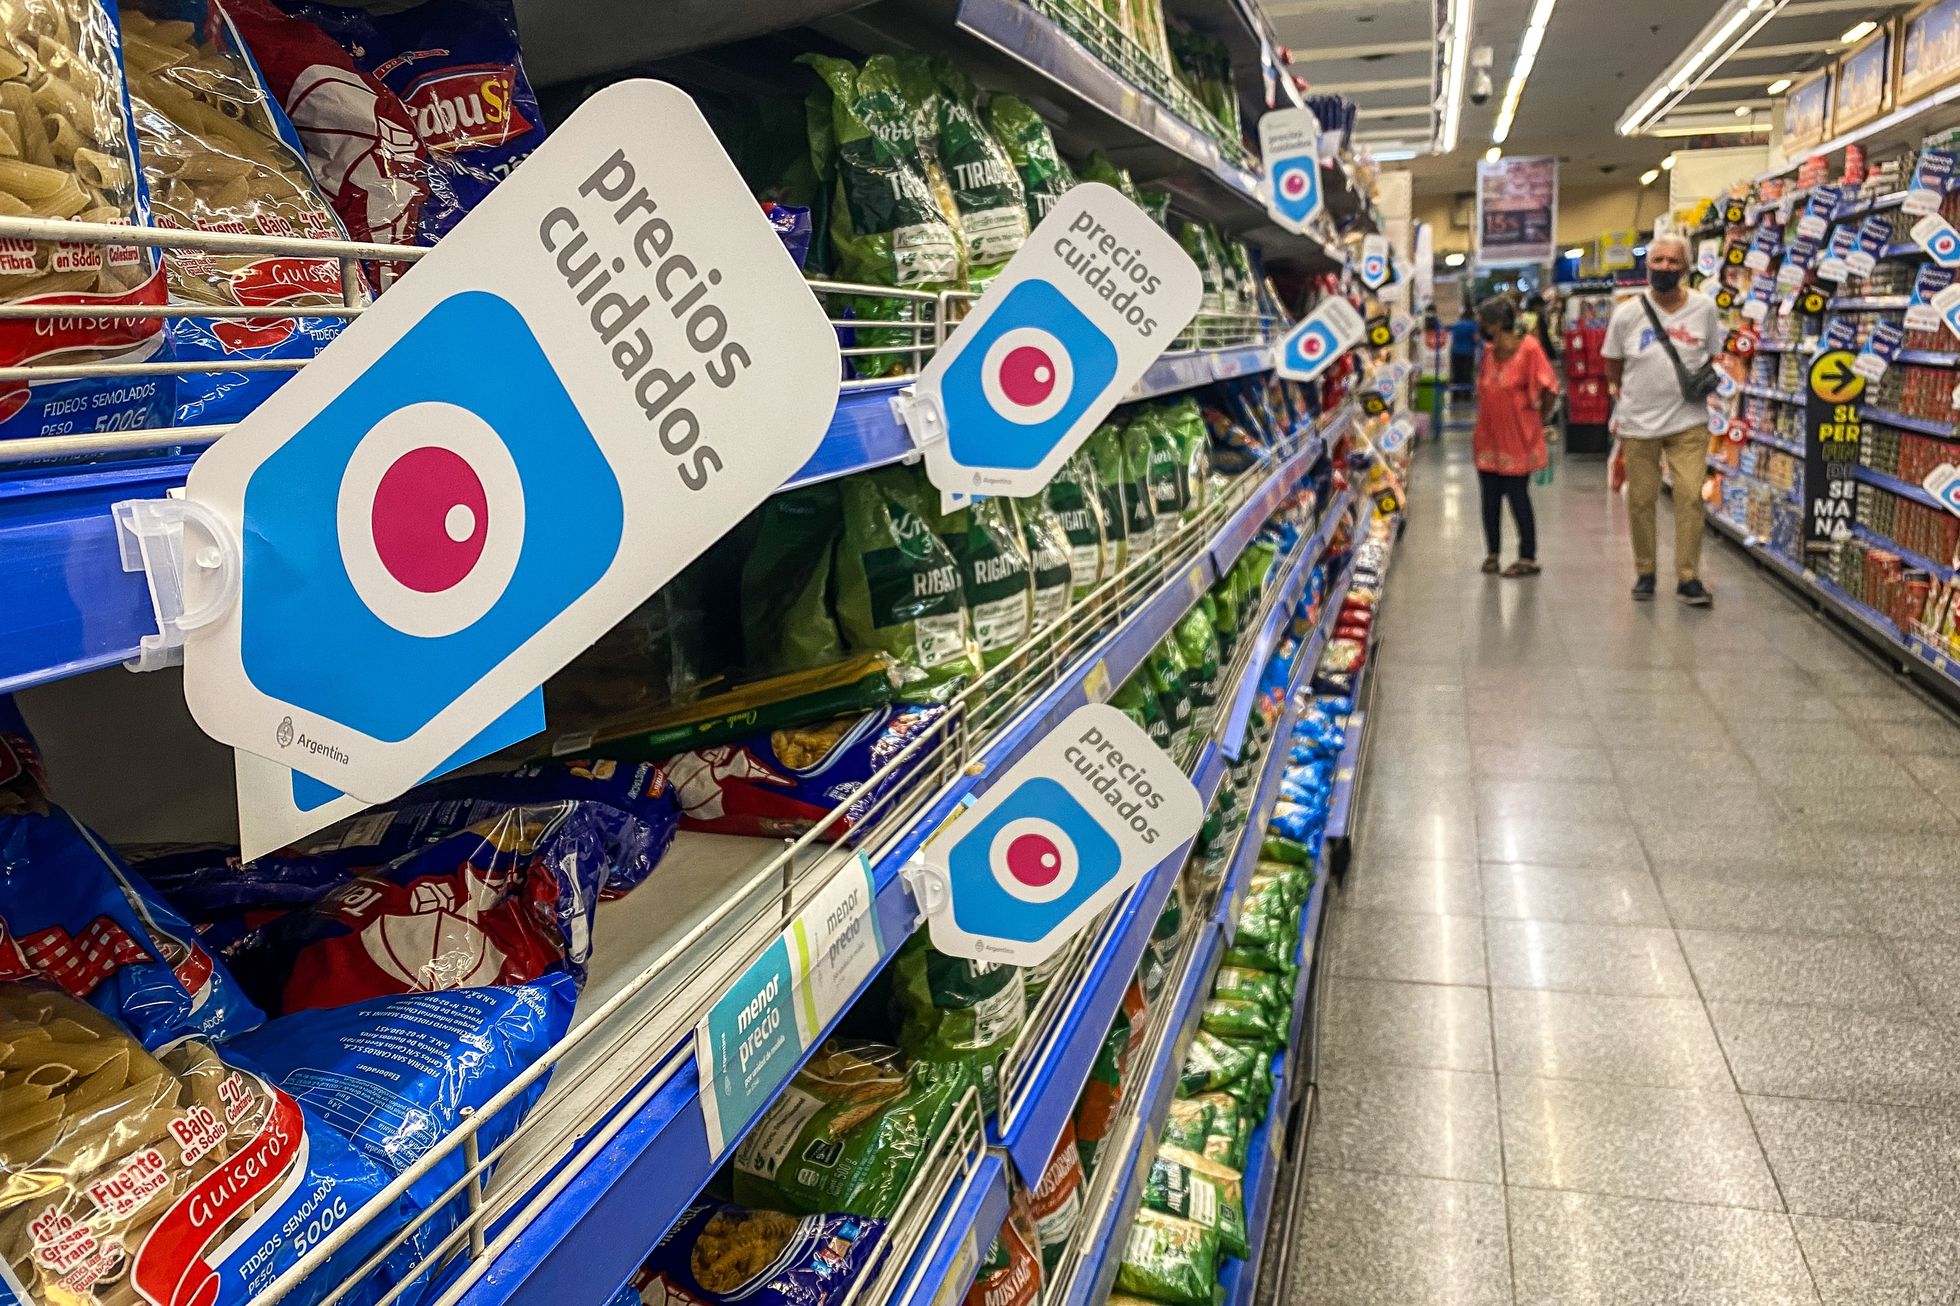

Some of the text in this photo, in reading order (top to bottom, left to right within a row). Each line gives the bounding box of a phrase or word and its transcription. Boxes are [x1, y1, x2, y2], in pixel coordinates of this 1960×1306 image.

[57, 255, 70, 268] en
[578, 148, 751, 389] precios
[1069, 210, 1162, 296] precios
[1054, 238, 1158, 338] cuidados
[540, 207, 723, 491] cuidados
[43, 382, 156, 418] FIDEOS SEMOLADOS
[40, 407, 147, 437] PESO 500G
[1819, 424, 1860, 442] PER
[1828, 480, 1855, 499] SE
[1814, 498, 1851, 518] MA
[297, 734, 350, 765] Argentina
[1079, 727, 1164, 809] precios
[1064, 746, 1160, 844] cuidados
[826, 887, 859, 935] menor
[828, 915, 861, 969] precio
[737, 973, 780, 1035] menor
[379, 1034, 407, 1044] Buenos
[406, 1038, 418, 1047] De
[454, 1020, 480, 1032] Parque
[738, 1007, 781, 1074] precio
[363, 1047, 391, 1059] CARLOS
[384, 1042, 408, 1053] Carlos
[391, 1054, 408, 1063] SAN
[418, 1042, 451, 1060] Provincia
[420, 1053, 443, 1068] Carlos
[356, 1064, 400, 1081] Elaborador:
[407, 1061, 440, 1078] FIDEERIA
[171, 1104, 214, 1145] Bajo
[185, 1124, 226, 1162] en Sodio
[92, 1150, 164, 1209] Fuente
[189, 1127, 289, 1228] Guiseros
[41, 1225, 91, 1263] Grasas
[239, 1177, 337, 1281] FIDEOS SEMOLADOS
[293, 1196, 348, 1258] 500G
[52, 1237, 96, 1270] Trans
[248, 1262, 275, 1296] PESO
